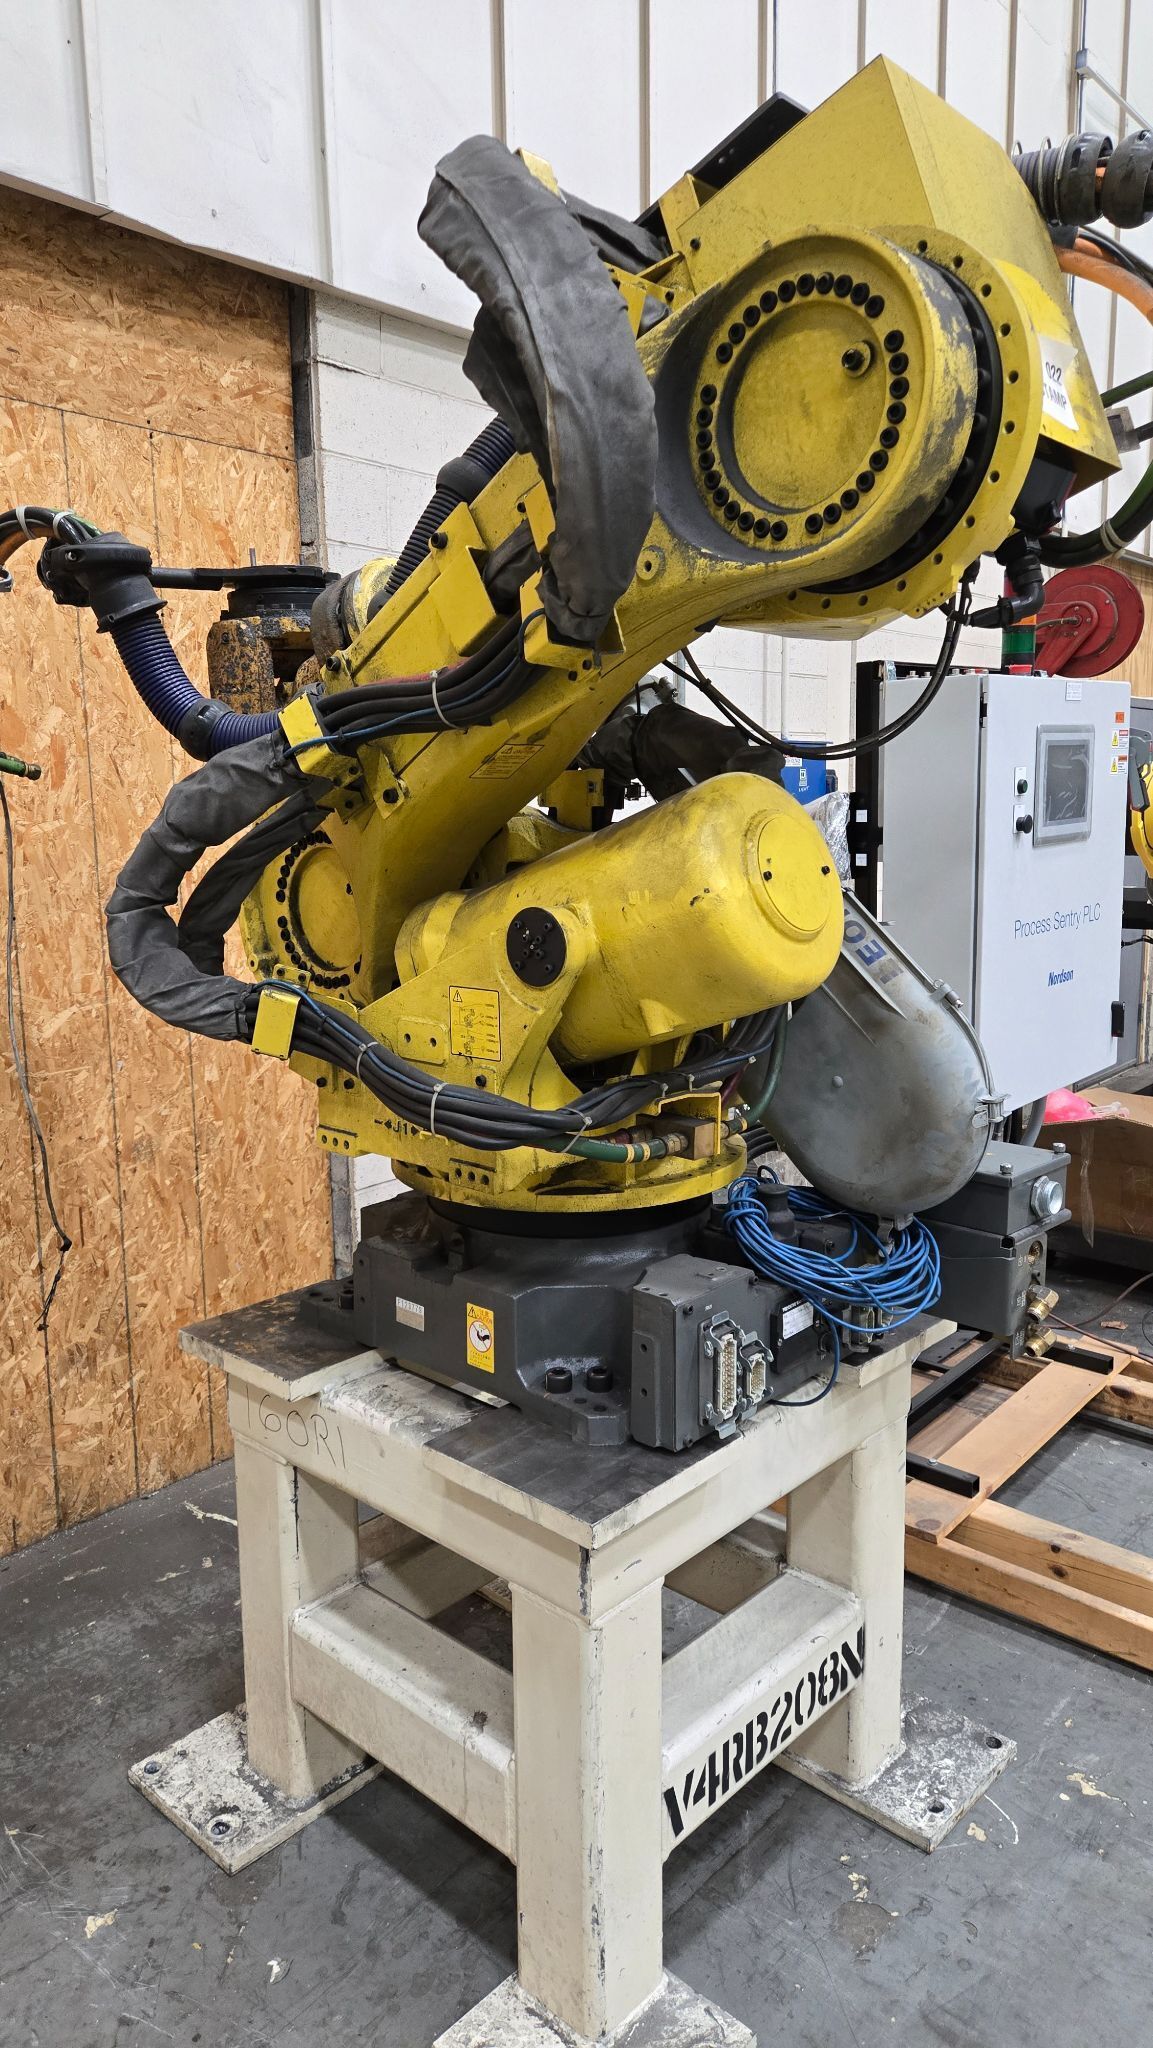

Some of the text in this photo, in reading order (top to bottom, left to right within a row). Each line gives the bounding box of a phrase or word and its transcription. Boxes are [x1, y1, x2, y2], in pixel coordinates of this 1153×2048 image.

[1014, 902, 1101, 940] Process Sentry PLC
[1047, 969, 1074, 987] Nordson
[663, 1623, 865, 1838] V4RB208N
